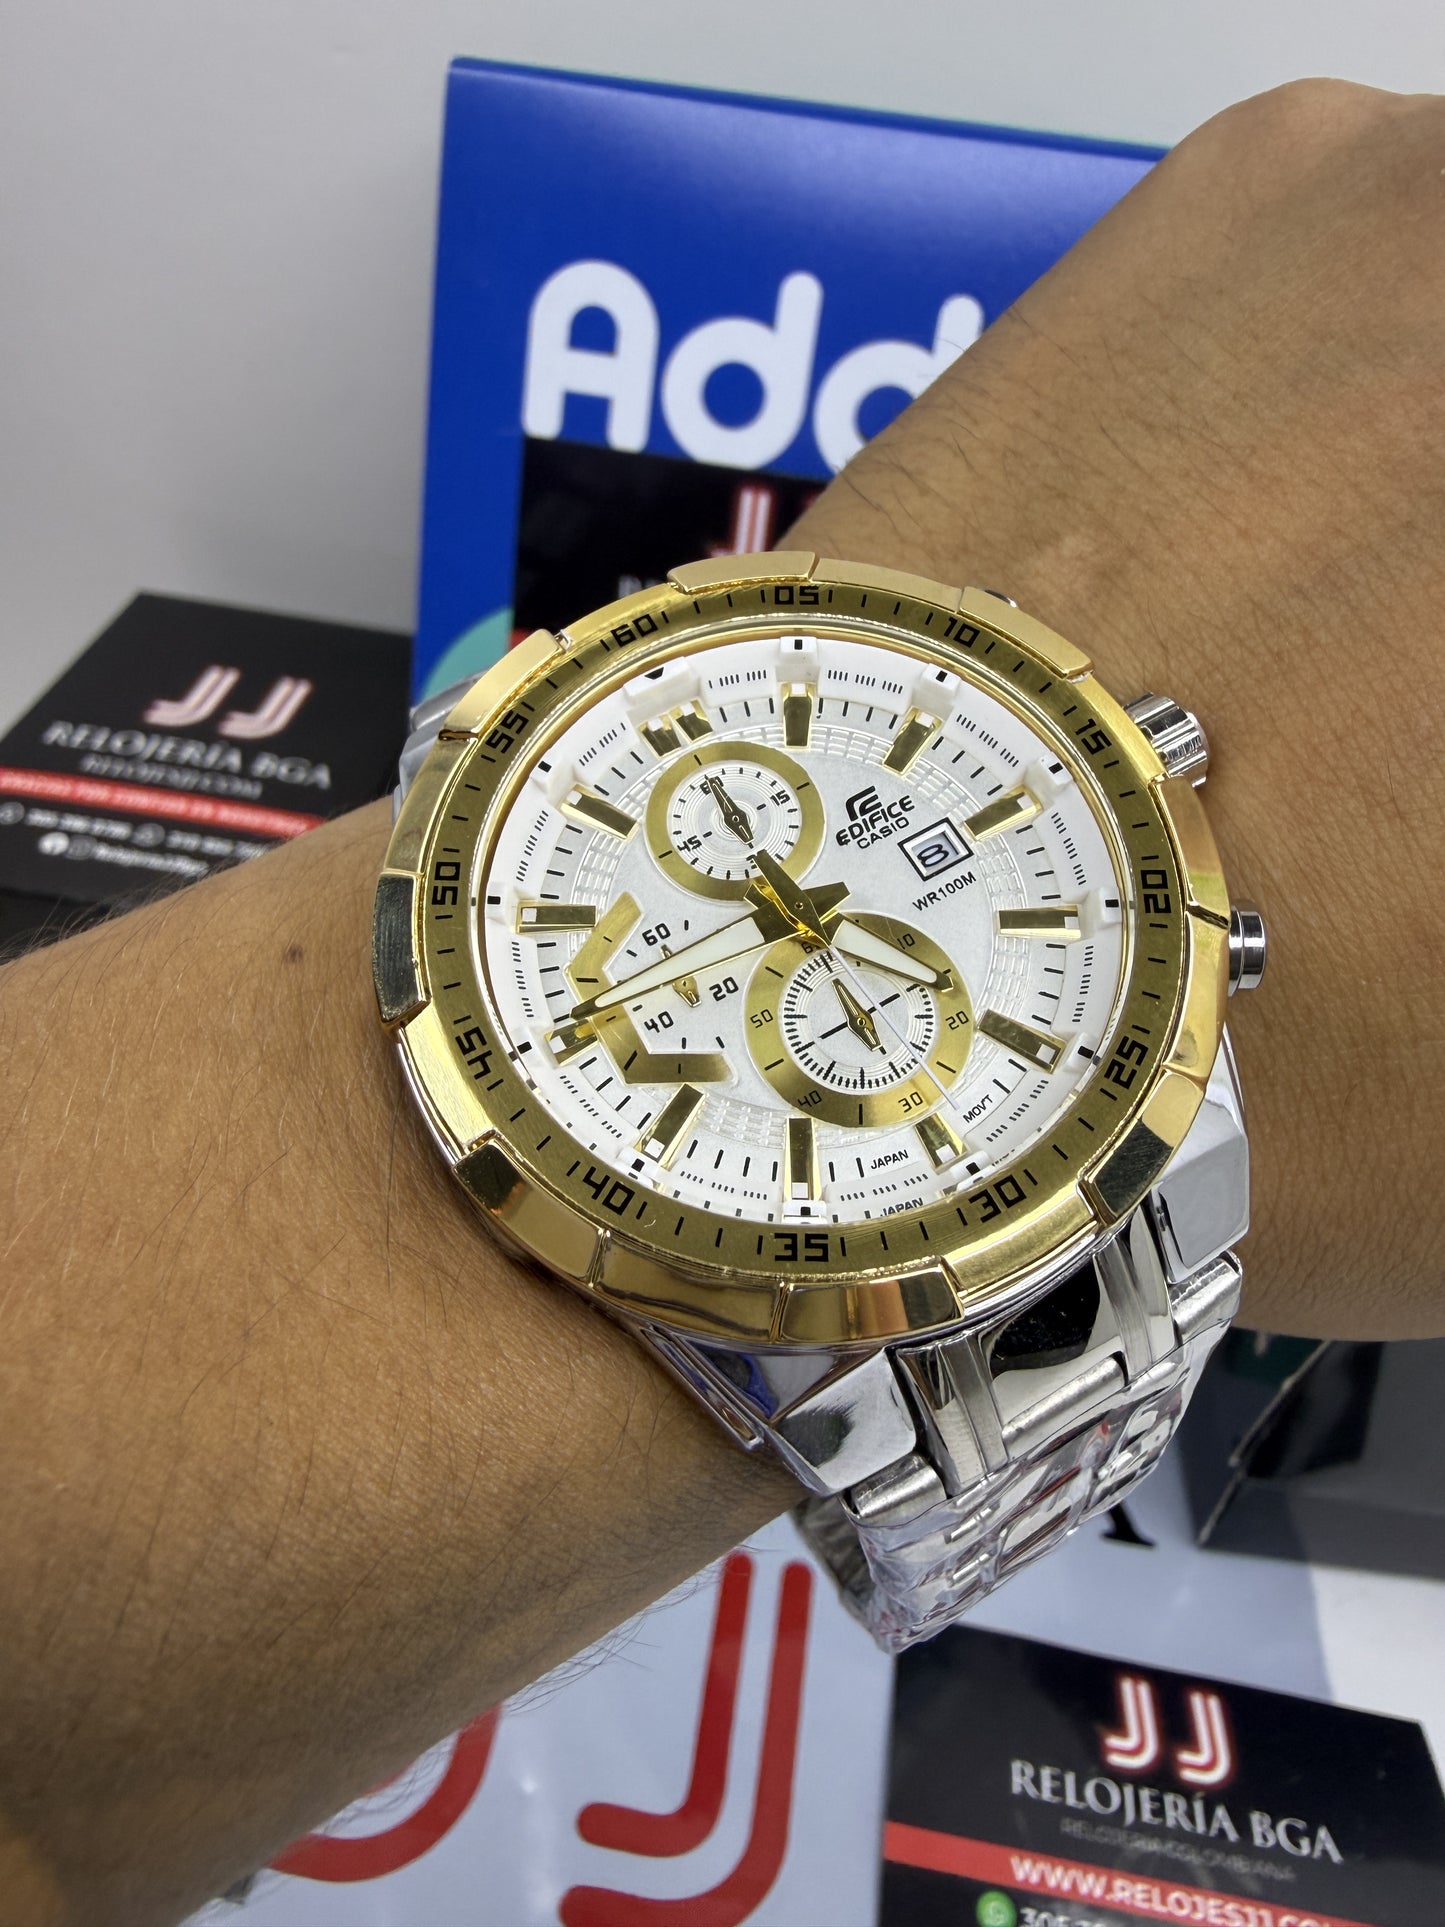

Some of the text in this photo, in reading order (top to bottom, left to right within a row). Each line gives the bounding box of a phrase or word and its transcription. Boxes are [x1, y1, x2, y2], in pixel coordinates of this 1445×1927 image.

[774, 585, 819, 605] 05
[611, 615, 657, 647] 60
[943, 617, 980, 648] 10
[486, 710, 529, 753] 55
[1075, 718, 1112, 755] 15
[770, 790, 790, 806] 15
[835, 795, 915, 847] EDIFICE
[857, 817, 909, 849] CASIO
[677, 835, 702, 852] 45
[916, 843, 950, 868] 8
[432, 861, 461, 905] 50
[912, 871, 977, 912] WR100M
[1140, 869, 1172, 914] 20
[642, 922, 671, 946] 60
[709, 976, 739, 1002] 20
[644, 1011, 674, 1033] 40
[750, 1008, 774, 1029] 50
[945, 1010, 969, 1031] 20
[455, 1025, 491, 1080] 45
[1104, 1036, 1149, 1089] 25
[797, 1090, 822, 1109] 40
[898, 1091, 924, 1114] 30
[870, 1149, 909, 1170] JAPAN
[582, 1167, 635, 1216] 40
[968, 1174, 1027, 1223] 30
[774, 1232, 829, 1262] 35
[1010, 1758, 1344, 1865] RELOJERÍA BGA
